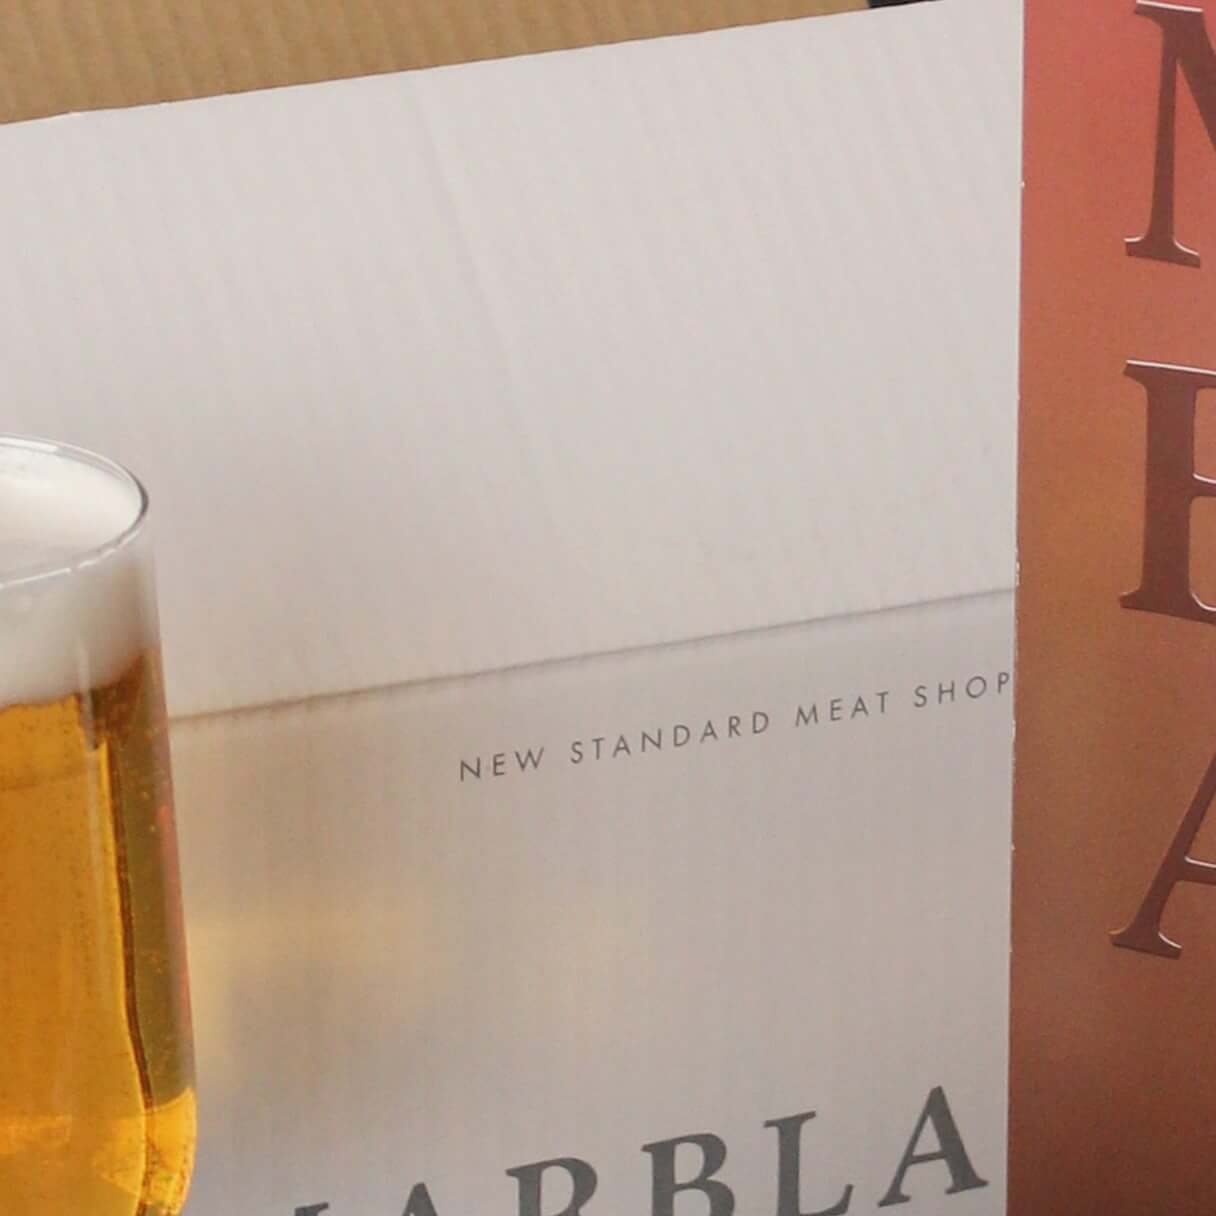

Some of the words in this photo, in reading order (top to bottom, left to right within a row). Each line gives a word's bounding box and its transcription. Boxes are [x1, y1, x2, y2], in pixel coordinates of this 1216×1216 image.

[459, 747, 545, 781] NEW
[570, 711, 771, 765] STANDARD
[794, 691, 890, 728] MEAT
[913, 671, 1011, 708] SHOP
